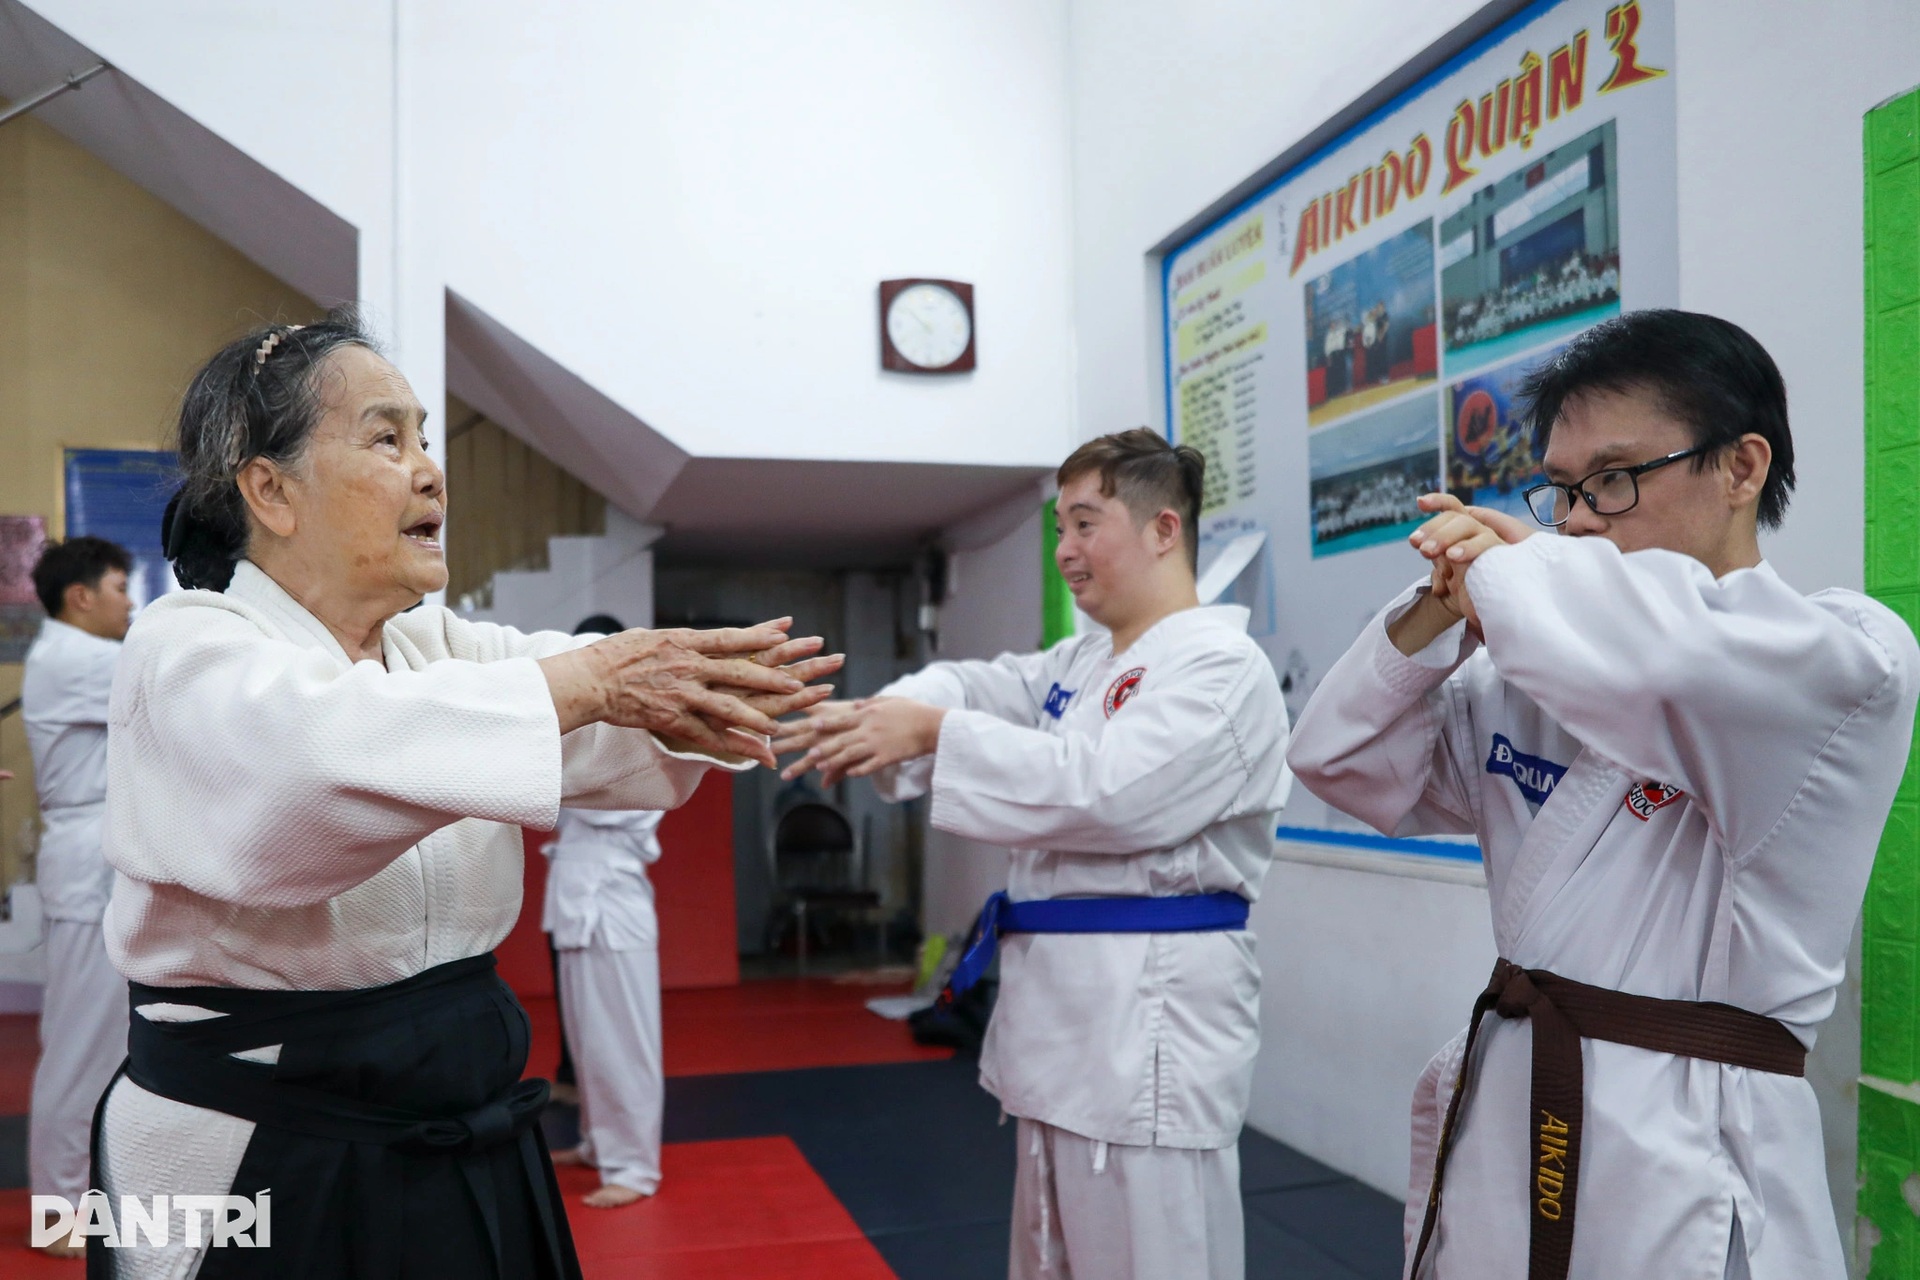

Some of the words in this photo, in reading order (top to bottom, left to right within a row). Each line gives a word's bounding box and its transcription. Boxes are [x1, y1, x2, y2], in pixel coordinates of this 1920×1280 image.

[1289, 132, 1433, 277] AIKIDO
[1441, 29, 1590, 196] QUẬN
[1597, 0, 1669, 95] 2
[1538, 1109, 1569, 1221] AIKIDO
